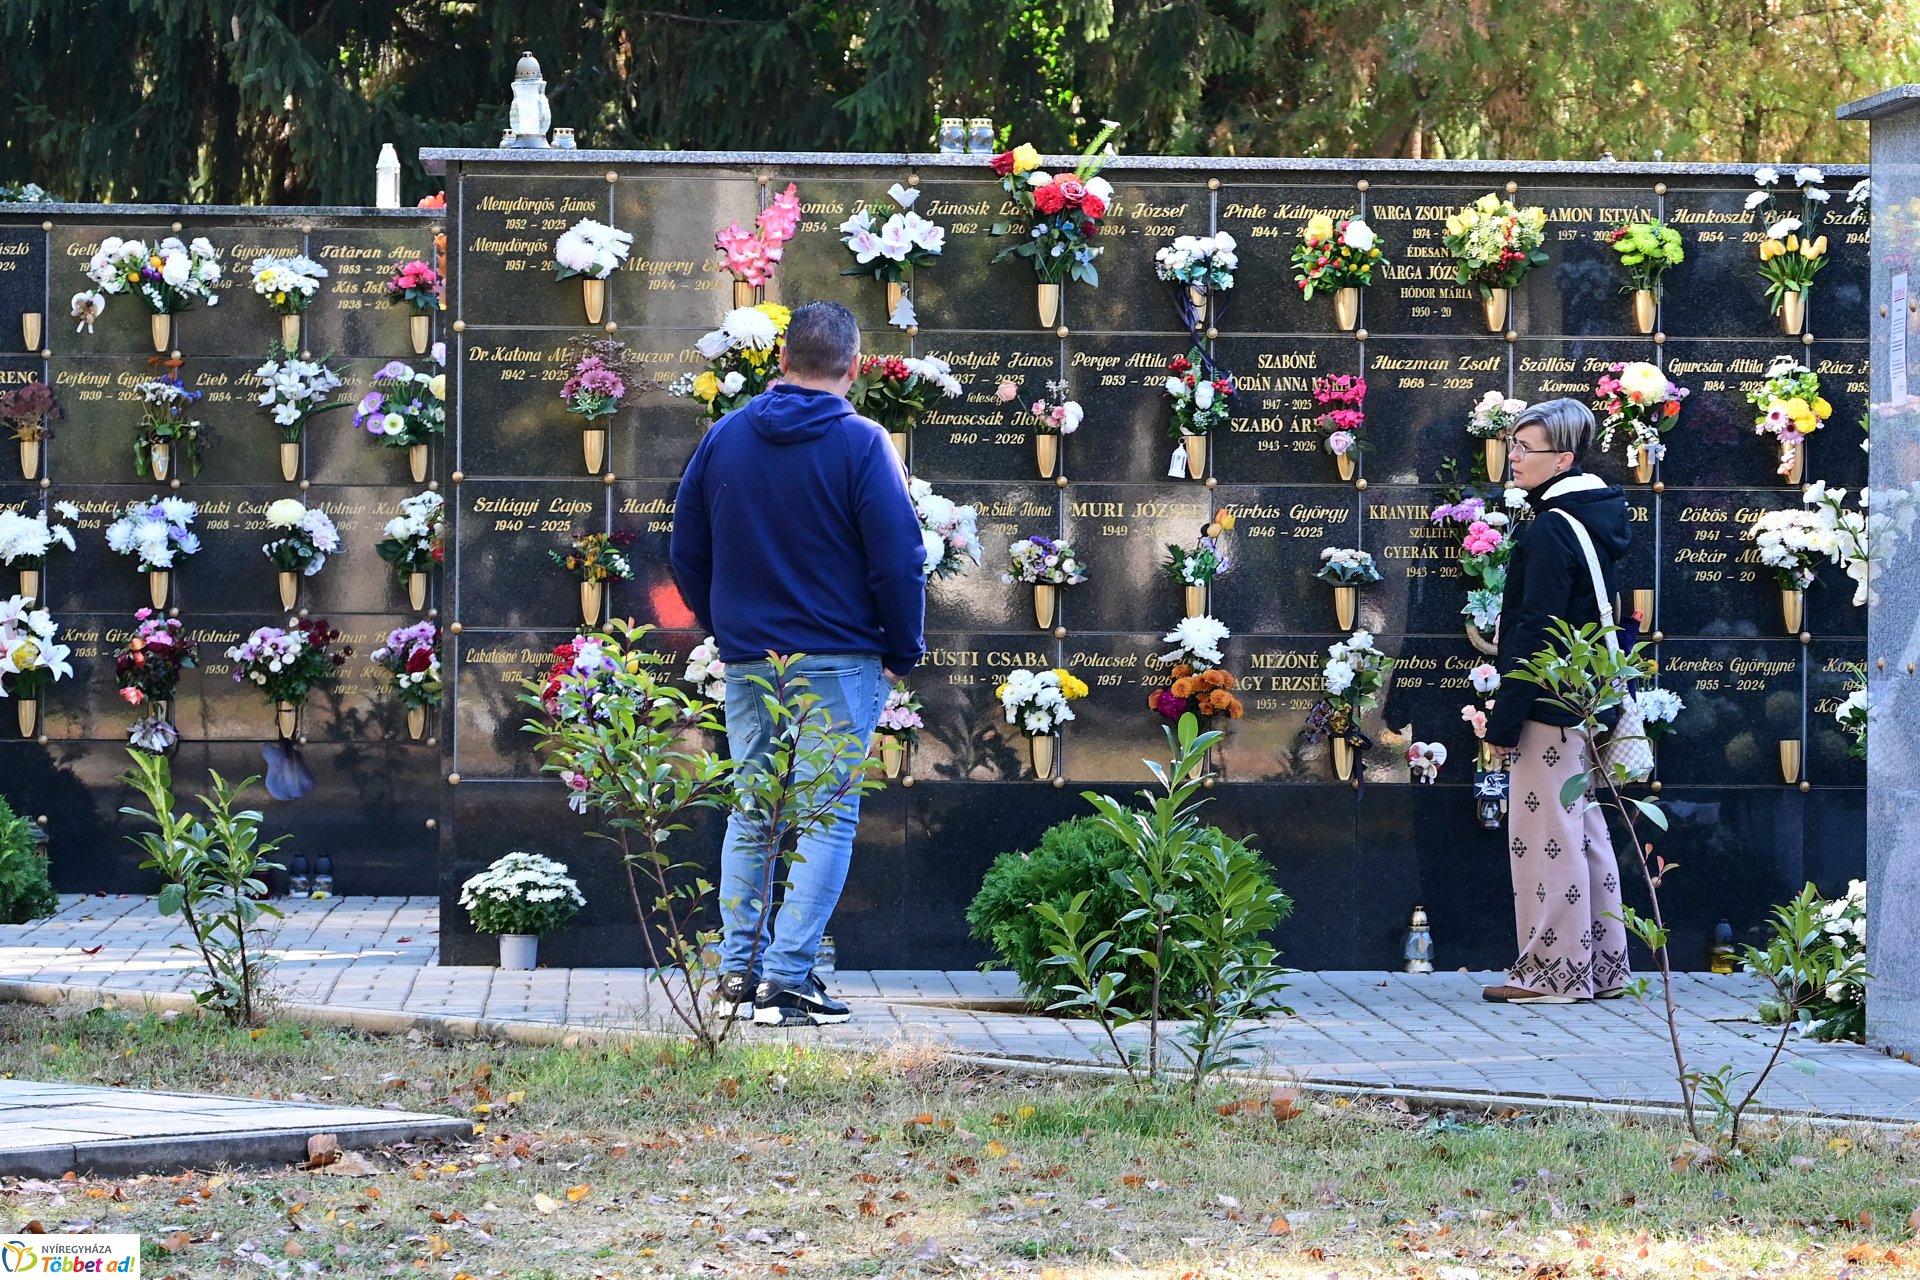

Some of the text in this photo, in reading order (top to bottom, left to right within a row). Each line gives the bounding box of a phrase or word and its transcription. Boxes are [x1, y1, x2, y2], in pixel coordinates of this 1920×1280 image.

[476, 196, 596, 215] Menydörgős János
[799, 202, 844, 214] omós
[926, 201, 991, 216] Jánosik
[1131, 203, 1188, 219] József
[1223, 204, 1266, 219] Pinte
[1373, 206, 1412, 220] VARGA
[1416, 206, 1454, 220] ZSOLT
[1545, 206, 1651, 223] AMON ISTVÁN
[1670, 209, 1755, 224] Hankoszki
[505, 219, 566, 230] 1952 2025
[801, 221, 827, 232] 1954
[951, 223, 1025, 234] 1962 026
[1100, 225, 1175, 236] 1934 2026
[1251, 227, 1278, 237] 1944
[1412, 228, 1431, 239] 1974
[1558, 230, 1612, 241] 1957 202
[1698, 232, 1724, 242] 1954
[388, 246, 421, 259] Ana
[469, 237, 548, 256] Menydörgős
[1407, 244, 1450, 258] ÉDESAN
[338, 265, 360, 274] 1953
[505, 260, 554, 271] 1951 20
[621, 257, 694, 275] Megyery
[1381, 262, 1460, 280] VARGA JÓZS
[332, 281, 388, 294] Kis Ist
[649, 280, 676, 290] 1944
[1400, 286, 1473, 299] HÓDOR MÁRIA
[338, 300, 361, 310] 1938
[1411, 307, 1430, 317] 1950
[1008, 352, 1053, 368] János
[1071, 352, 1120, 371] Perger
[1125, 353, 1167, 368] Attila
[1258, 351, 1317, 369] SZABÓNÉ
[1371, 355, 1501, 371] Huczman Zsolt
[1519, 357, 1576, 372] Szöllősi
[1817, 359, 1853, 374] Rácz
[1669, 358, 1723, 376] Gyurcsán
[1726, 358, 1763, 373] Attila
[56, 371, 111, 388] Lejtényi
[196, 370, 264, 387] Lieb Árp
[501, 370, 569, 381] 1942 2025
[1100, 375, 1168, 386] 1953 202
[1232, 373, 1271, 391] OGDÁN
[1274, 377, 1308, 391] ANNA
[1399, 378, 1473, 389] 1968 2025
[1538, 379, 1590, 393] Kormos
[1703, 381, 1725, 391] 1984
[79, 391, 102, 401] 1939
[209, 392, 231, 402] 1954
[1262, 400, 1312, 410] 1947 2025
[921, 410, 1042, 426] Harascsák Ilon
[1230, 414, 1283, 432] SZABÓ
[950, 433, 1025, 444] 1940 2026
[1258, 440, 1316, 451] 1943 2026
[473, 497, 592, 517] Szilágyi Lajos
[620, 499, 676, 514] Hadhá
[1020, 502, 1051, 517] Ilona
[1071, 503, 1124, 518] MURI
[1369, 505, 1429, 520] KRANYIK
[1289, 504, 1349, 523] György
[77, 520, 100, 530] 1943
[207, 520, 228, 530] 1968
[494, 520, 570, 531] 1940 2025
[992, 524, 1019, 535] 2025
[1102, 525, 1128, 536] 1949
[1248, 527, 1324, 538] 1946 2025
[1694, 530, 1720, 541] 1941
[1384, 543, 1439, 559] GYERÁK
[1675, 548, 1727, 563] Pekár
[1406, 567, 1459, 578] 1943 202
[1694, 571, 1722, 582] 1950
[61, 629, 98, 643] Krón
[75, 648, 97, 658] 1955
[986, 652, 1049, 667] CSABA
[1070, 652, 1138, 667] Polacsek
[1250, 651, 1319, 669] MEZŐNÉ
[1393, 655, 1437, 670] mbos
[1665, 656, 1796, 676] Kerekes Györgyné
[205, 665, 229, 675] 1950
[501, 671, 522, 682] 1976
[948, 674, 975, 685] 1941
[1097, 675, 1172, 686] 1951 2026
[1232, 676, 1264, 691] AGY
[1396, 677, 1470, 688] 1969 2026
[1695, 679, 1766, 691] 1955 2024
[1256, 699, 1313, 710] 1955 2026
